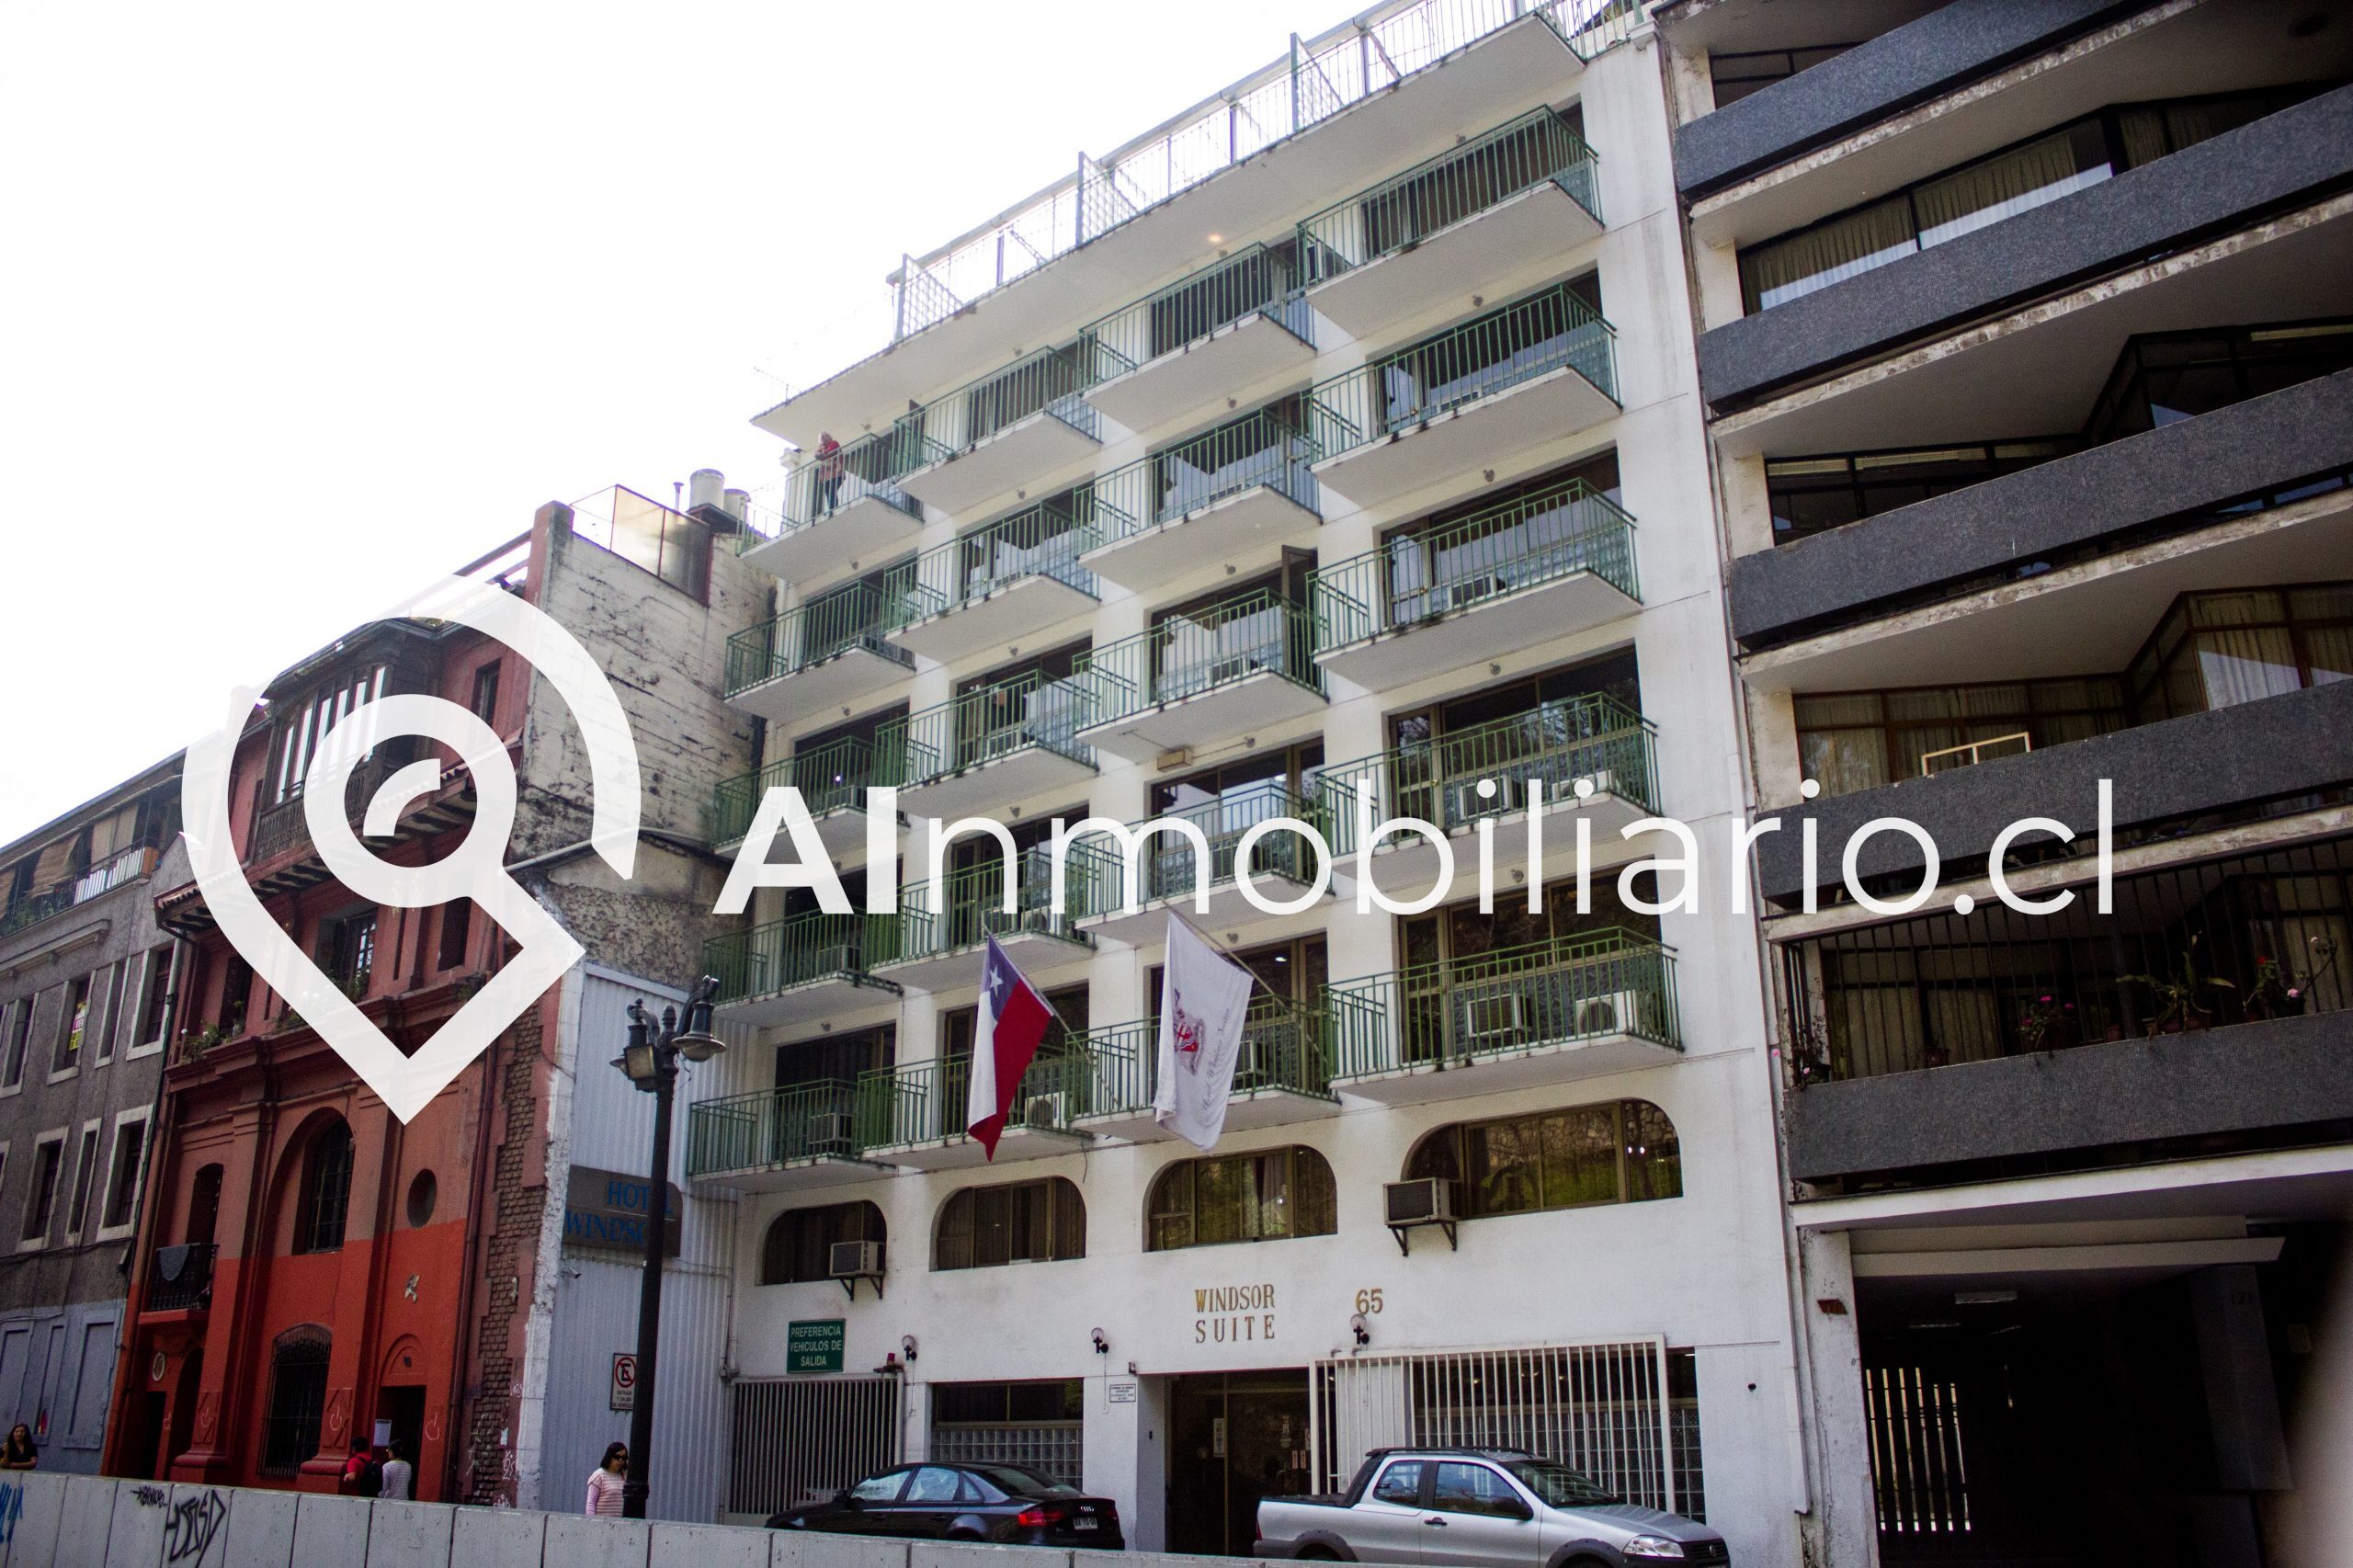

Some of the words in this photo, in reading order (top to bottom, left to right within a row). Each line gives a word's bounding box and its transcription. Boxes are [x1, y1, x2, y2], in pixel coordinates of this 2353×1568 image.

[608, 1180, 674, 1214] HOTL
[1195, 1284, 1276, 1313] WINDSOR
[1355, 1289, 1383, 1315] 65
[790, 1325, 841, 1338] PREFERENCIA
[1195, 1314, 1276, 1344] SUITE
[790, 1340, 829, 1352] VEHICULOS
[831, 1340, 842, 1351] DE
[801, 1356, 827, 1367] SALIDA
